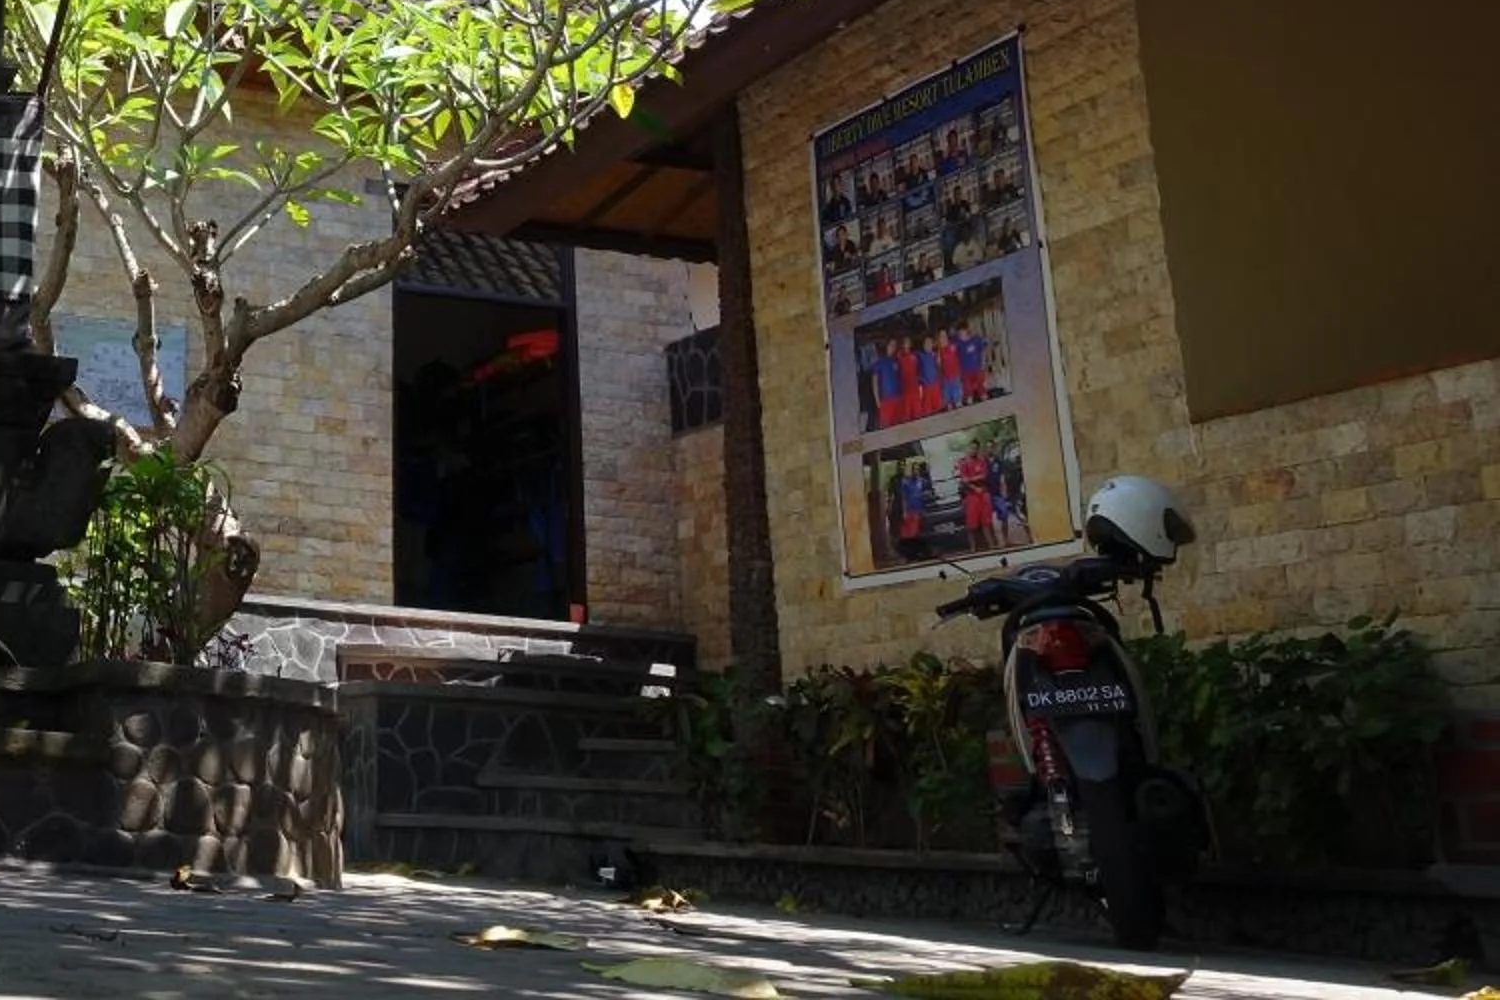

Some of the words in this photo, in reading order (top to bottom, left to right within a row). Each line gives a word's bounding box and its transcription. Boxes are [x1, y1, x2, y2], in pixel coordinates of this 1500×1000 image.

[893, 84, 938, 117] RESORT
[942, 47, 1010, 96] TULAMBEN
[1027, 691, 1052, 707] DK
[1055, 687, 1099, 703] 8802
[1101, 684, 1125, 699] SA
